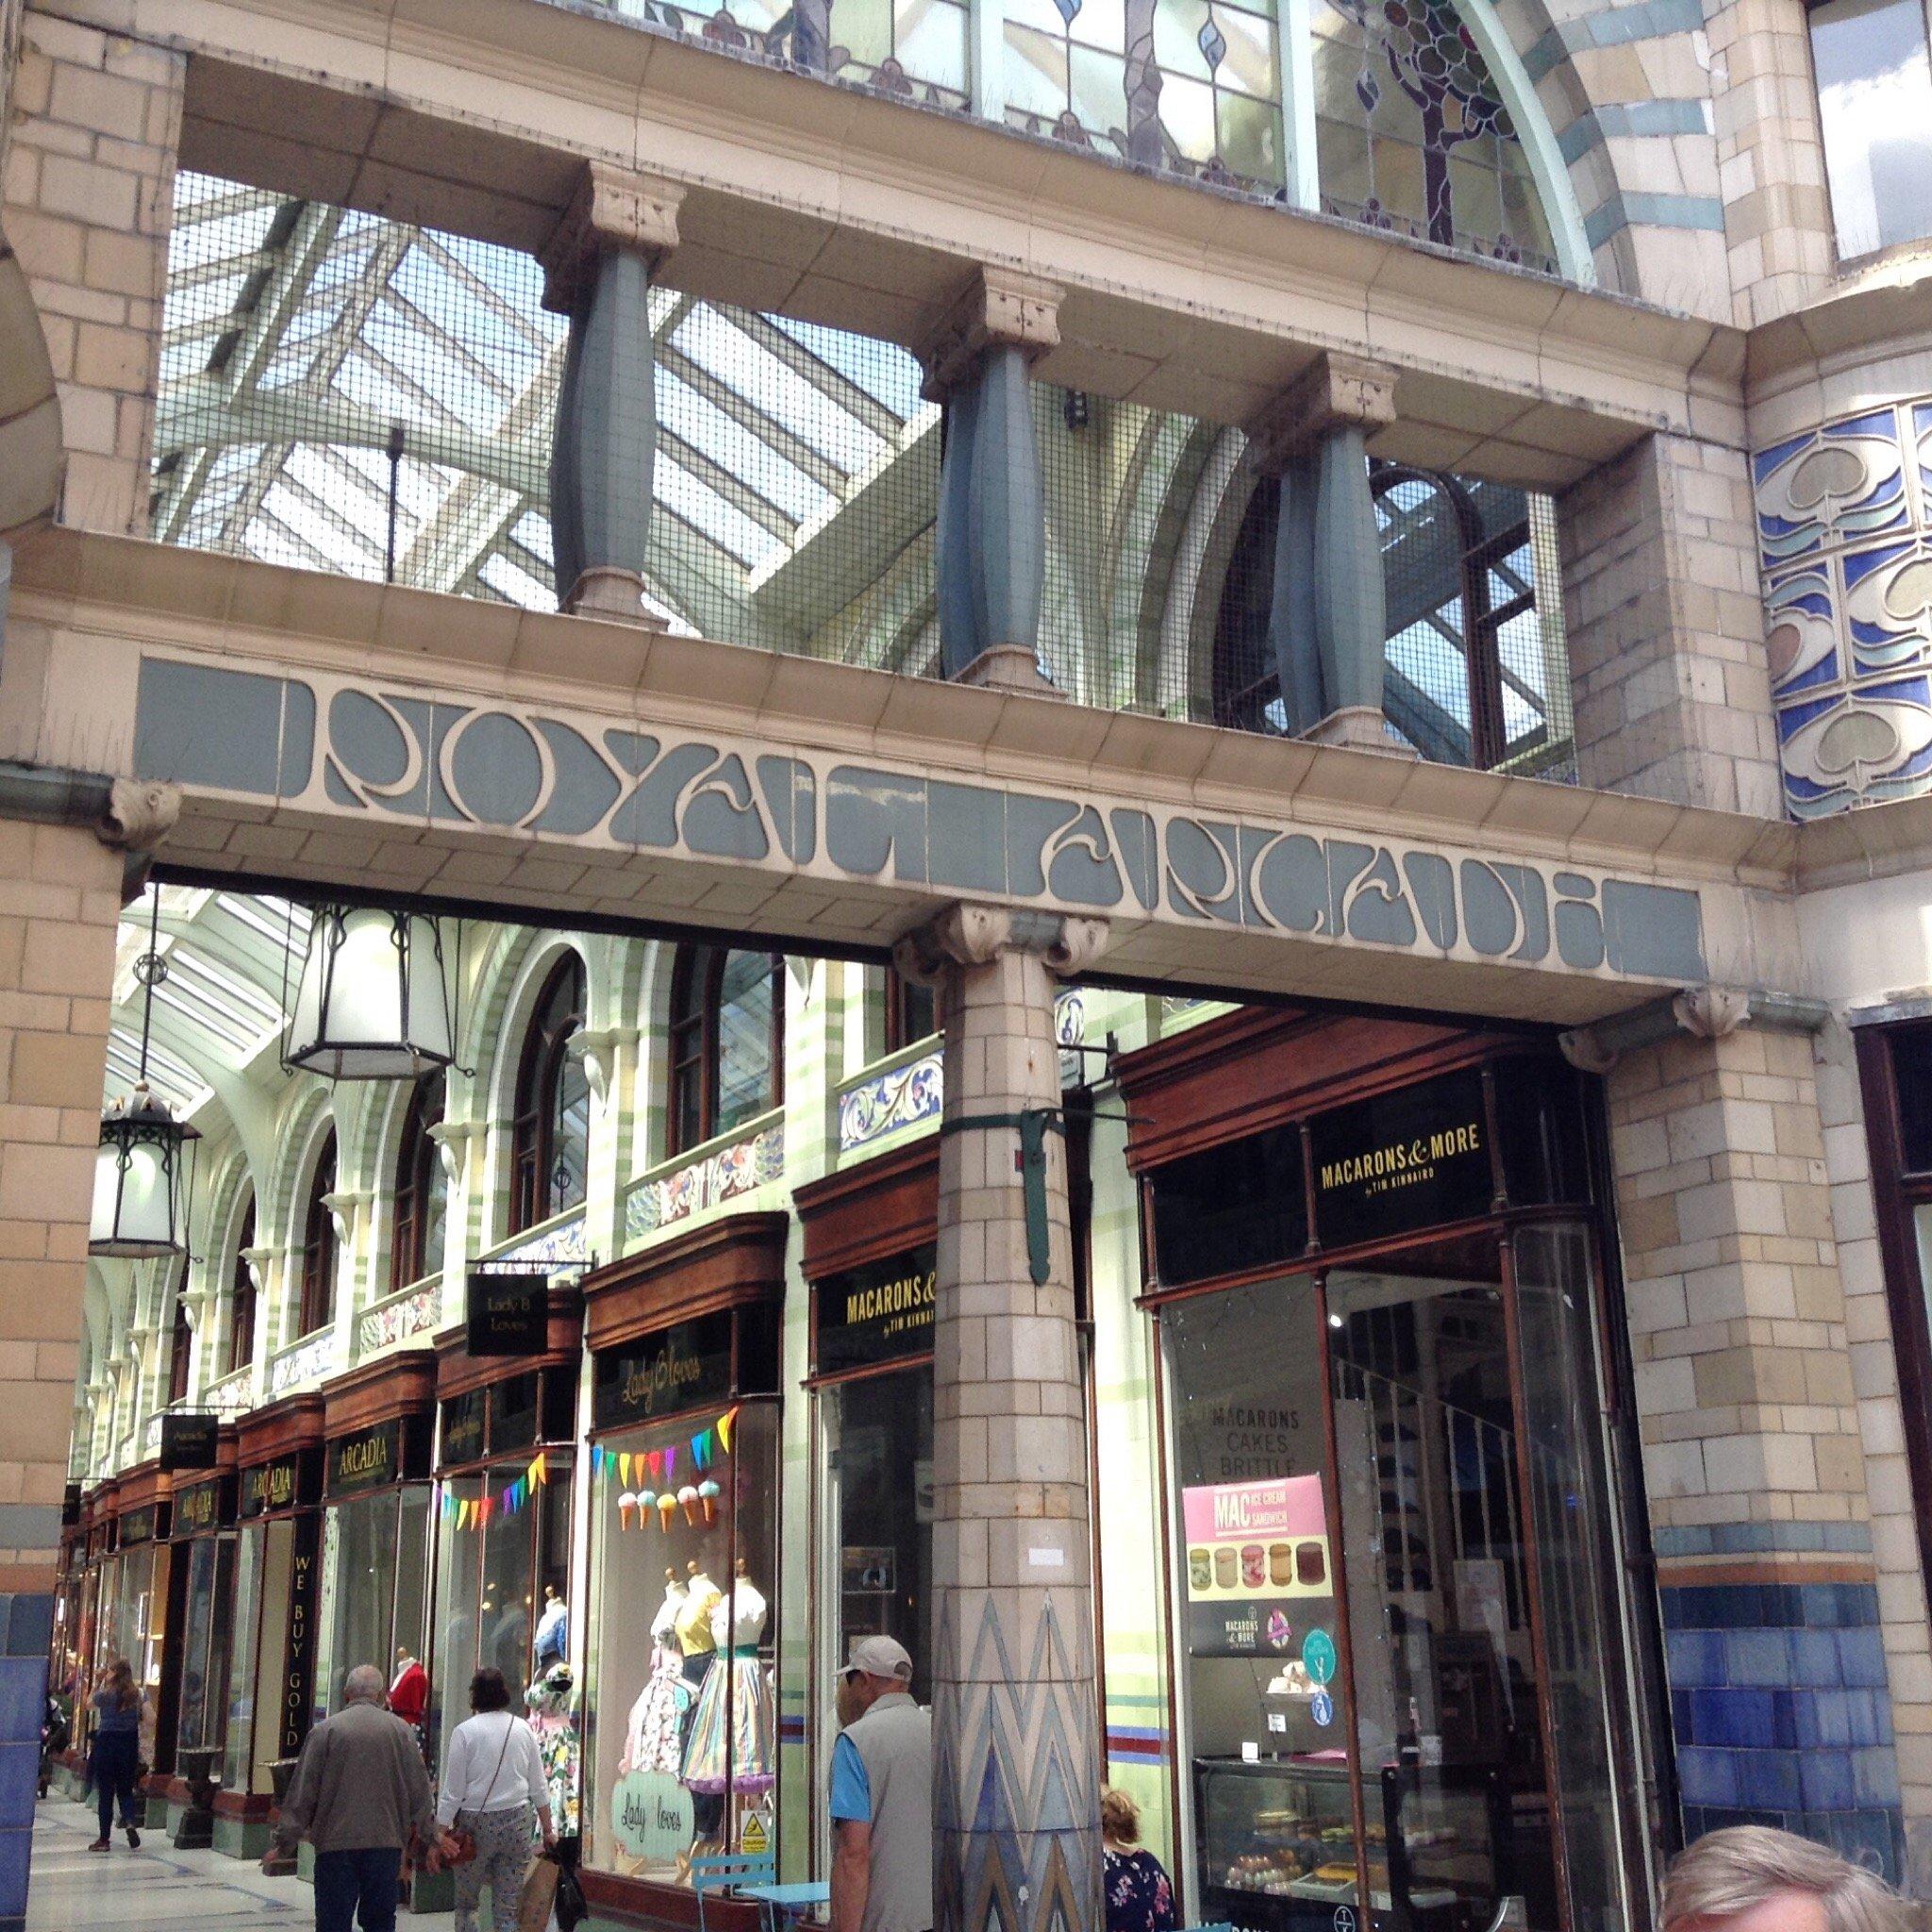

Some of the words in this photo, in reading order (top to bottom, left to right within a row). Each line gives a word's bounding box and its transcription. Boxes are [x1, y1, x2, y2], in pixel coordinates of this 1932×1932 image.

[302, 674, 896, 885] ROYAL
[1038, 801, 1612, 975] ARCADE
[1323, 1143, 1407, 1190] MACARONS
[1431, 1123, 1479, 1160] MORE
[847, 1275, 922, 1324] MACARONS
[1212, 1407, 1299, 1430] MACARONS
[1226, 1432, 1289, 1454] CAKES
[339, 1436, 387, 1476] ARCADIA
[1214, 1492, 1250, 1528] MAC
[295, 1557, 310, 1591] WE
[292, 1605, 305, 1657] BUY
[287, 1673, 302, 1746] GOLD
[622, 1791, 645, 1843] Lady
